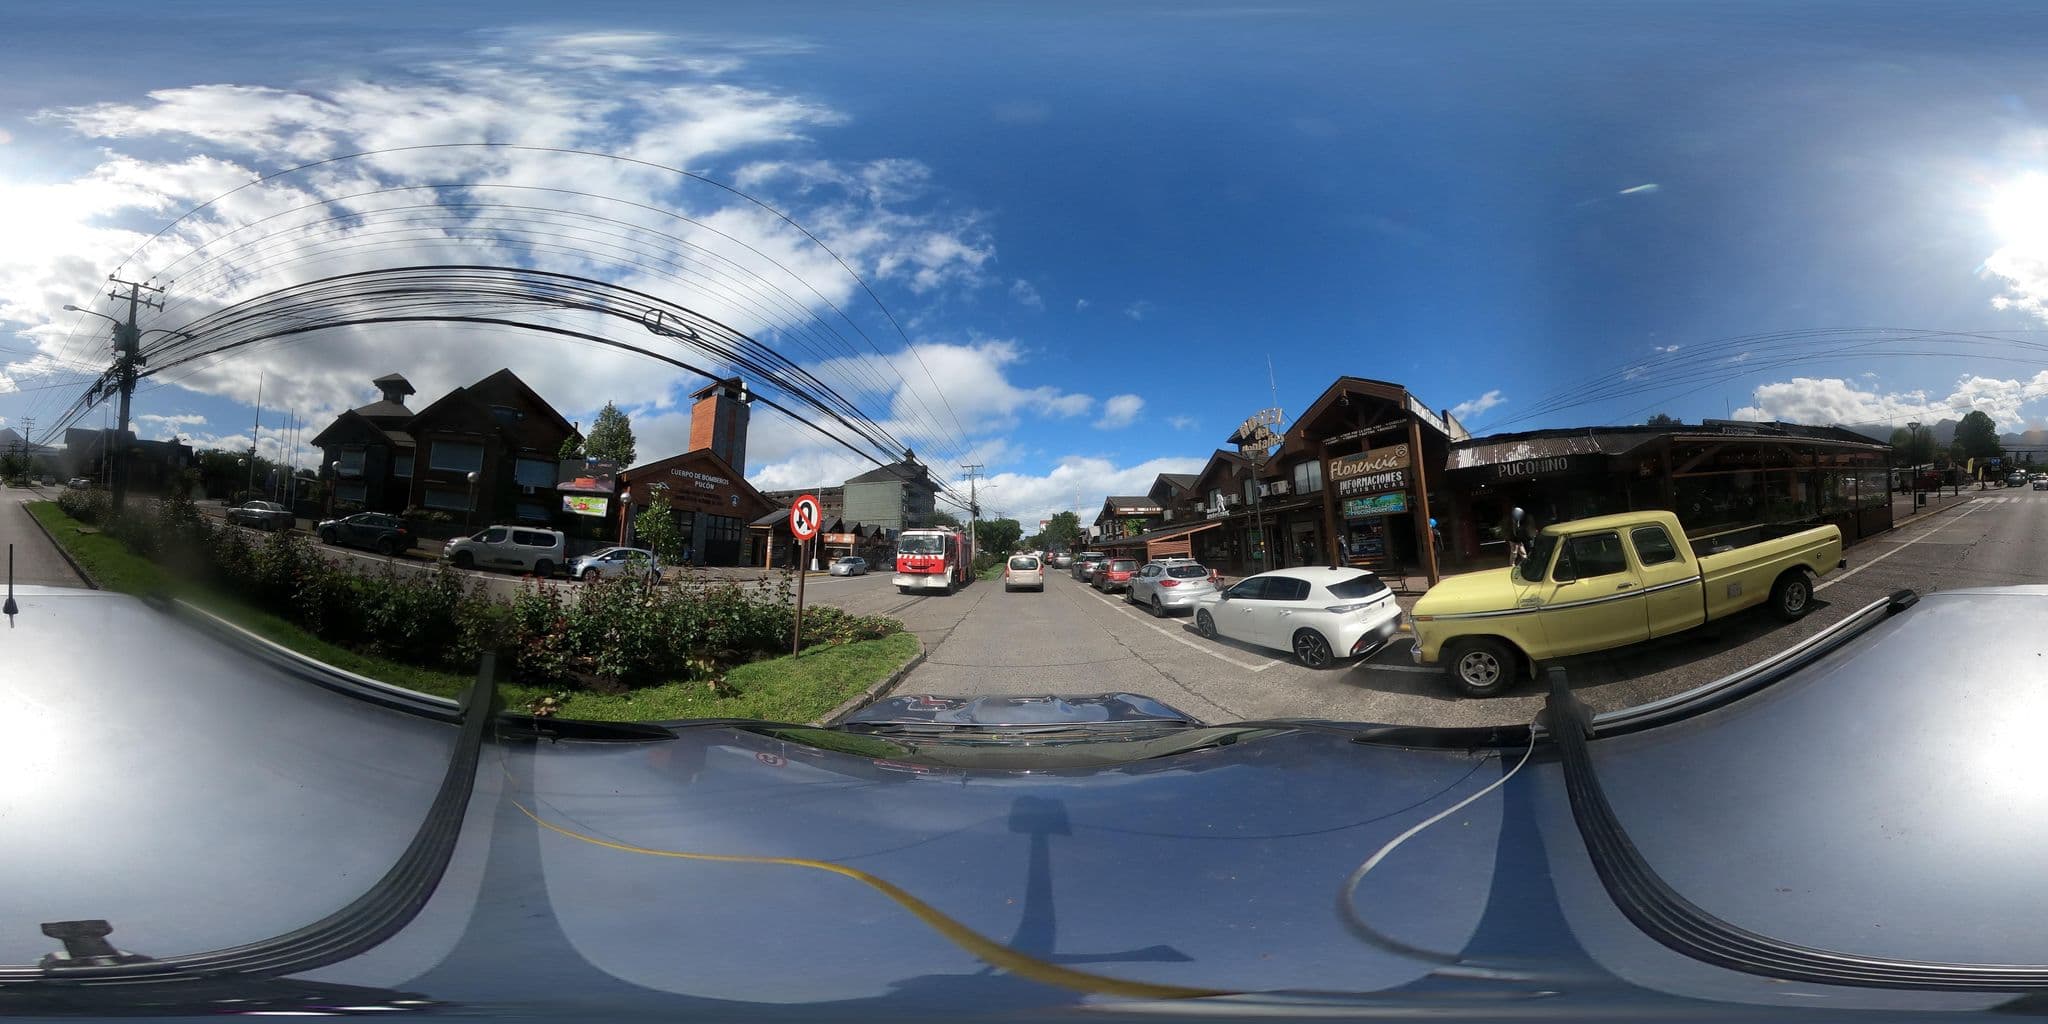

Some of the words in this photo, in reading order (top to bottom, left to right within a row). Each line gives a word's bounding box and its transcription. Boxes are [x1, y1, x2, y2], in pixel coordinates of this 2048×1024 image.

[670, 468, 694, 478] CUERPO
[702, 474, 729, 485] BOMBEROS
[1330, 454, 1398, 480] Florencia
[1497, 457, 1568, 478] PUCONINO
[1339, 471, 1403, 491] INFORMACIONES
